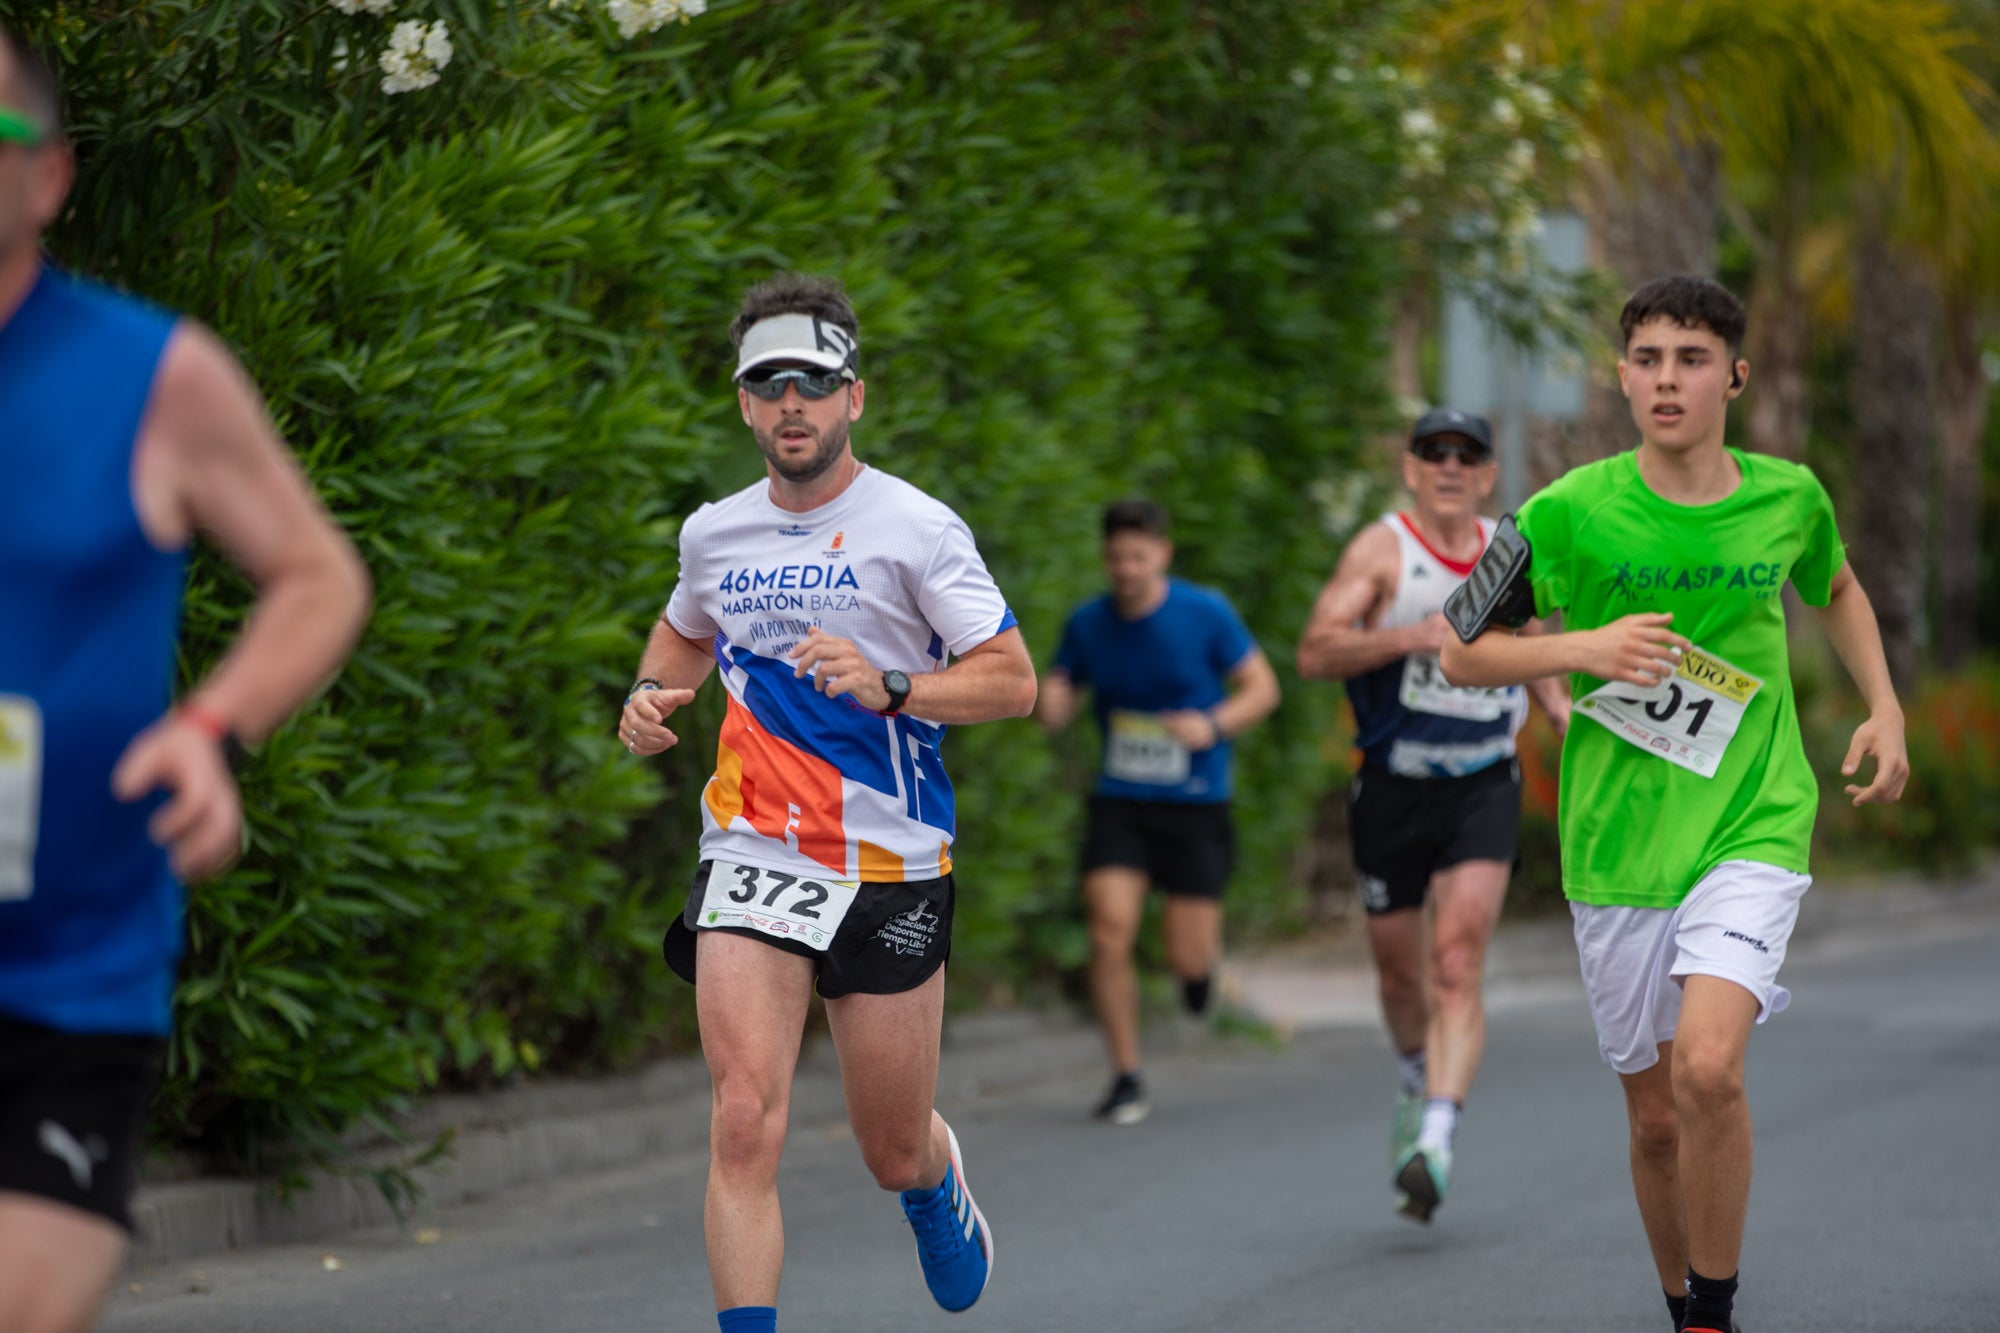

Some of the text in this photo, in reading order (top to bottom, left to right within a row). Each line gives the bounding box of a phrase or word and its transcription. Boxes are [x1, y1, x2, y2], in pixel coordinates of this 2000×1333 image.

[721, 591, 860, 617] MARATÓN BAZA
[767, 620, 787, 638] POR
[1616, 683, 1715, 738] 01
[728, 865, 829, 920] 372
[877, 929, 908, 945] Tiempo
[884, 922, 922, 940] Deportes
